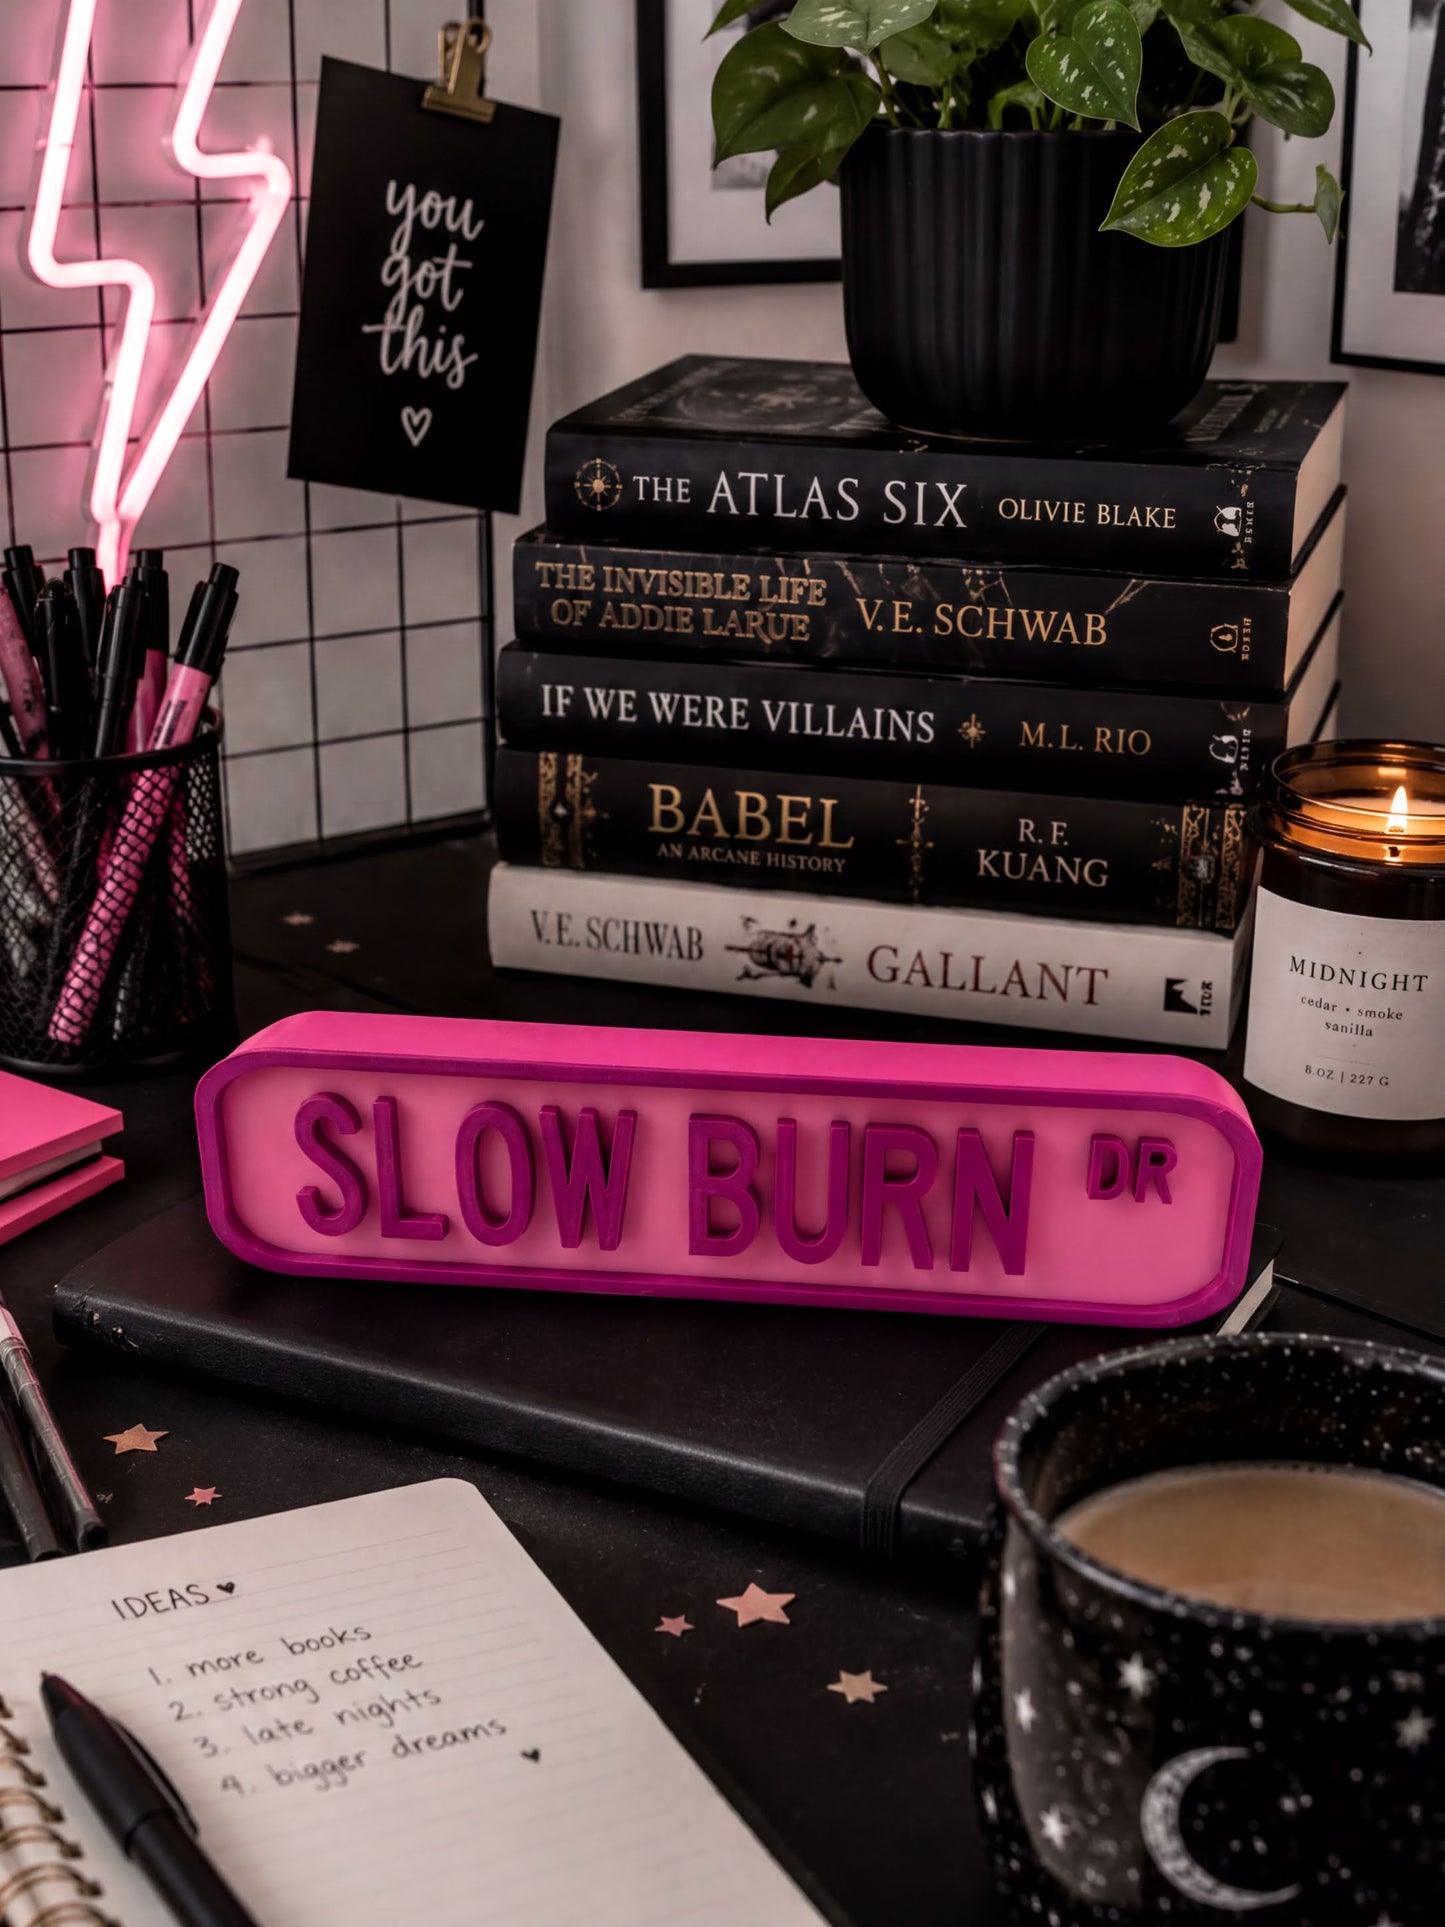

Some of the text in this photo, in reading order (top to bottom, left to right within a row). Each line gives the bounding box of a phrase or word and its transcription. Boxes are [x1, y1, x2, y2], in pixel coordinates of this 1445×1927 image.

[384, 178, 486, 257] you
[380, 242, 474, 334] got
[360, 303, 480, 390] this
[632, 470, 968, 528] THE ATLAS SIX
[998, 497, 1177, 530] OLIVIE BLAKE
[535, 561, 828, 607] THE INVISIBLE LIFE
[551, 598, 812, 645] OF ADDIE LARUE
[933, 603, 1108, 647] SCHWAB
[541, 684, 936, 744] IF WE WERE VILLAINS
[1093, 727, 1153, 756] RIO
[646, 784, 855, 849] BABEL
[656, 844, 846, 875] AN ARCANE HISTORY
[976, 849, 1110, 888] KUANG
[586, 917, 705, 962] SCHWAB
[866, 945, 1110, 1006] GALLANT
[1289, 955, 1429, 992] MIDNIGHT
[1300, 995, 1404, 1021] cedar smoke
[1349, 1074, 1374, 1086] 227
[1378, 1076, 1390, 1087] G
[294, 1091, 1178, 1276] SLOW BURN DR
[110, 1583, 211, 1621] IDEAS
[187, 1648, 265, 1678] more
[281, 1624, 372, 1657] books
[168, 1650, 424, 1722] 2. strong coffee
[242, 1718, 315, 1748] late
[334, 1686, 442, 1729] nights
[270, 1749, 368, 1792] bigger
[391, 1715, 508, 1759] dreams
